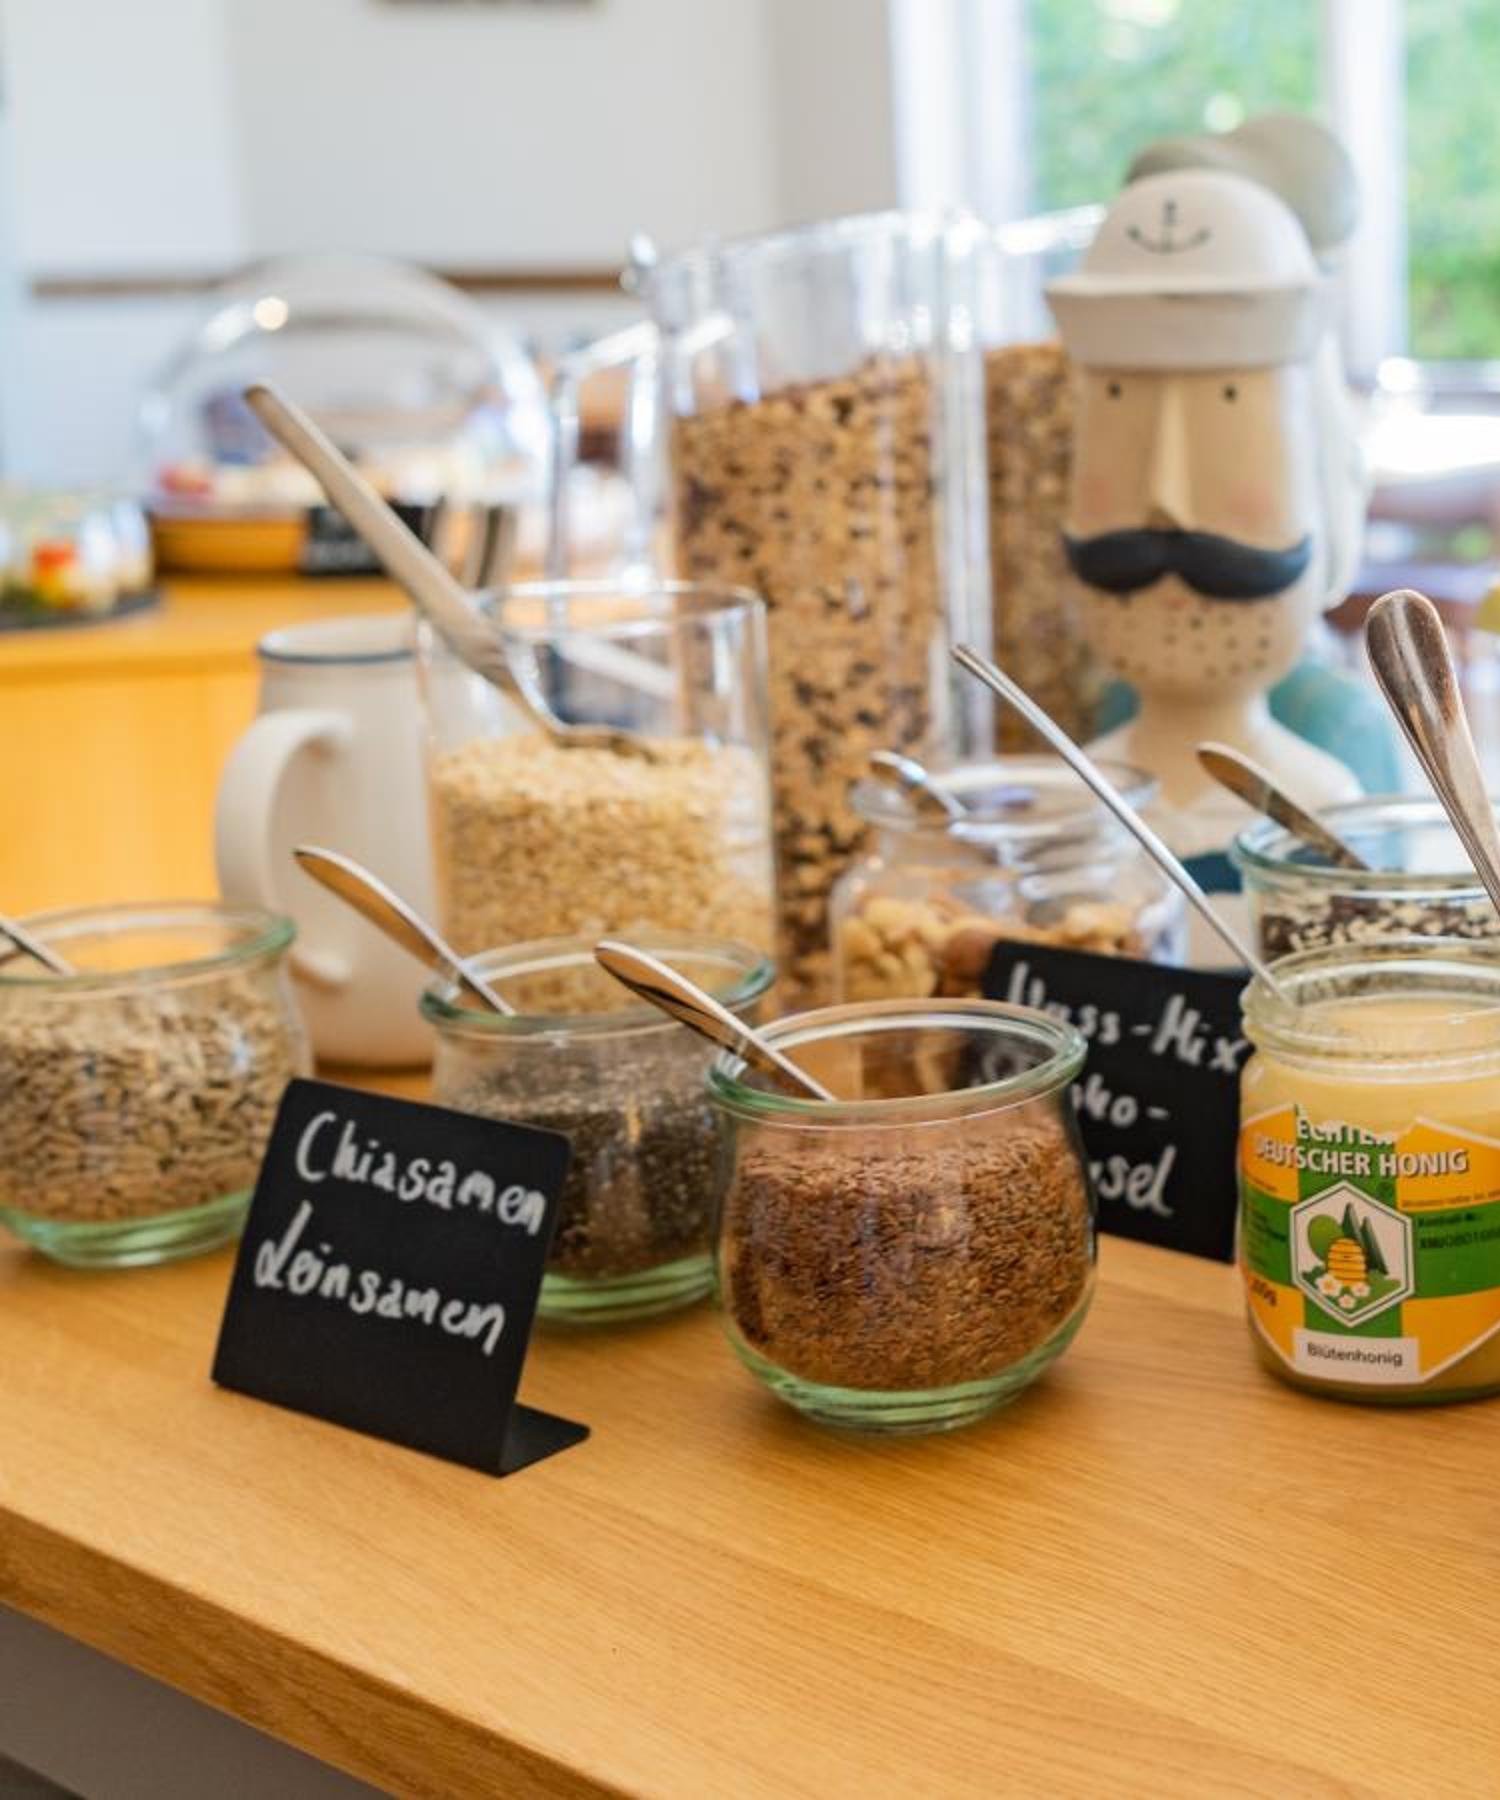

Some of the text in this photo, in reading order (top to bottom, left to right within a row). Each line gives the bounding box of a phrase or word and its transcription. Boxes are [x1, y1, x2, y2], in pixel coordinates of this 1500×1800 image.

[297, 1111, 546, 1236] Chiasamen
[1379, 1147, 1469, 1179] HONIG
[254, 1201, 505, 1356] Leinsamen
[1307, 1341, 1403, 1367] Blütenhonig
